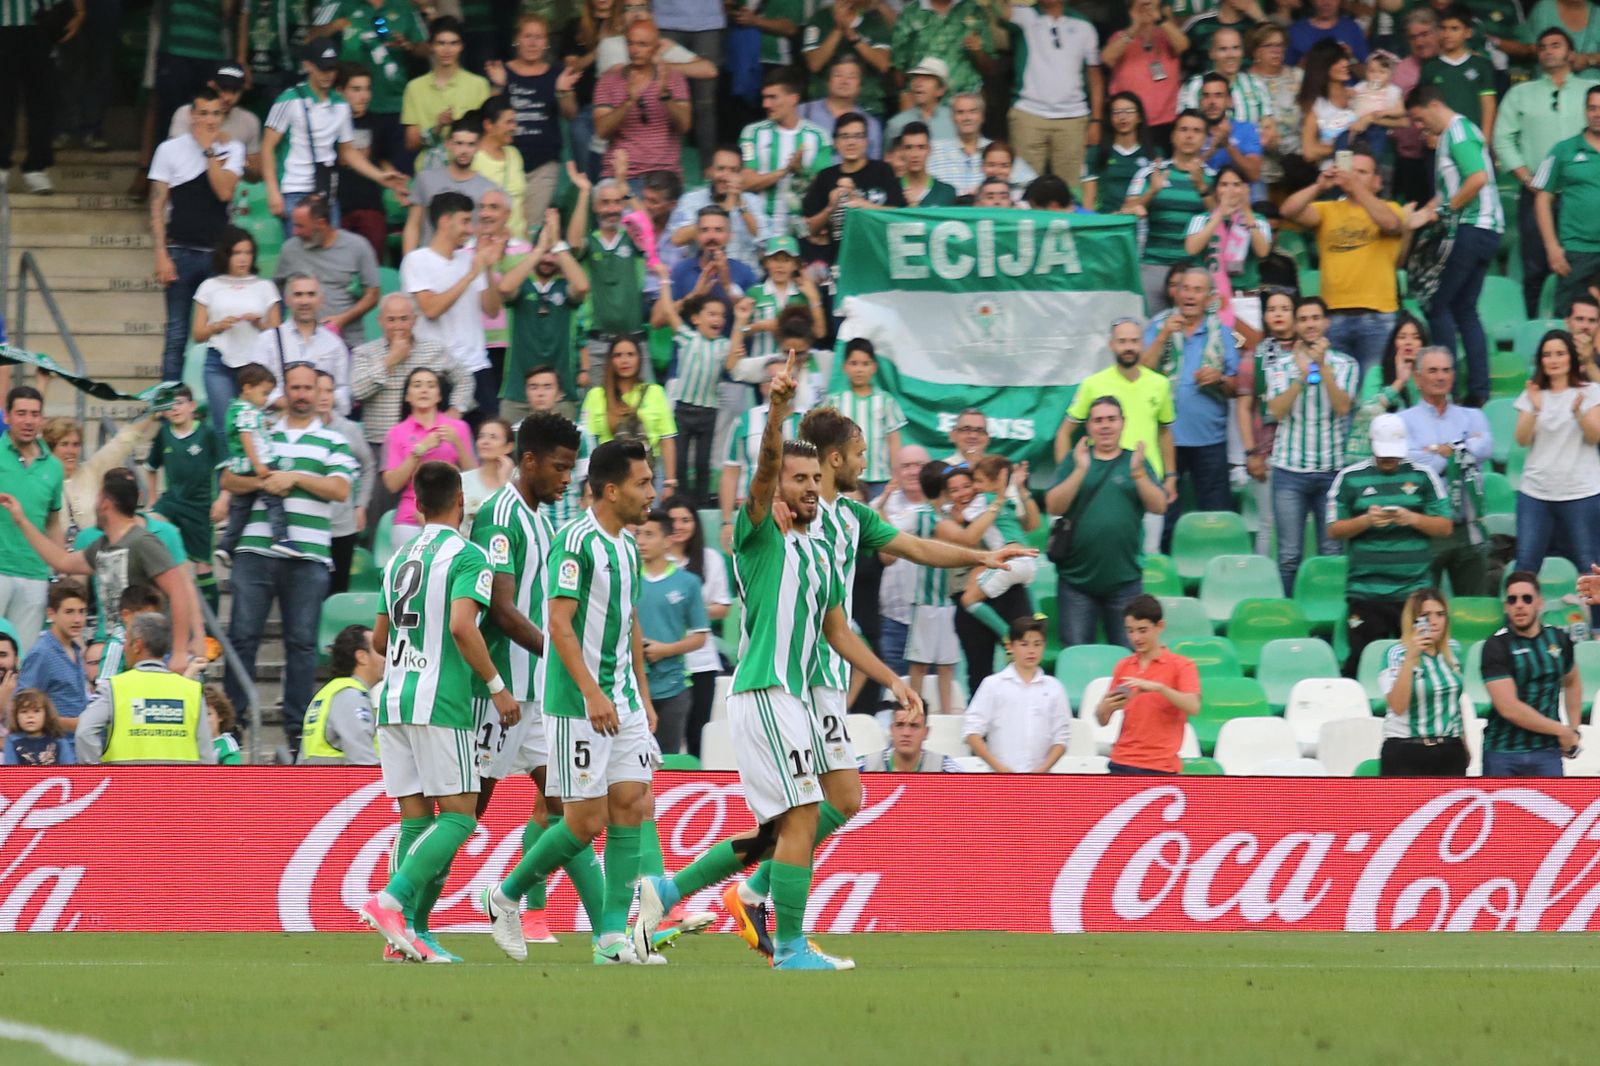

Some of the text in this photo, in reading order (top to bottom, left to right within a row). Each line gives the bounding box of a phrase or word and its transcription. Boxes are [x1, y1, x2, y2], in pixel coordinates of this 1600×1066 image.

[887, 219, 1083, 280] ECIJA
[393, 560, 424, 630] 2
[574, 740, 592, 768] 5
